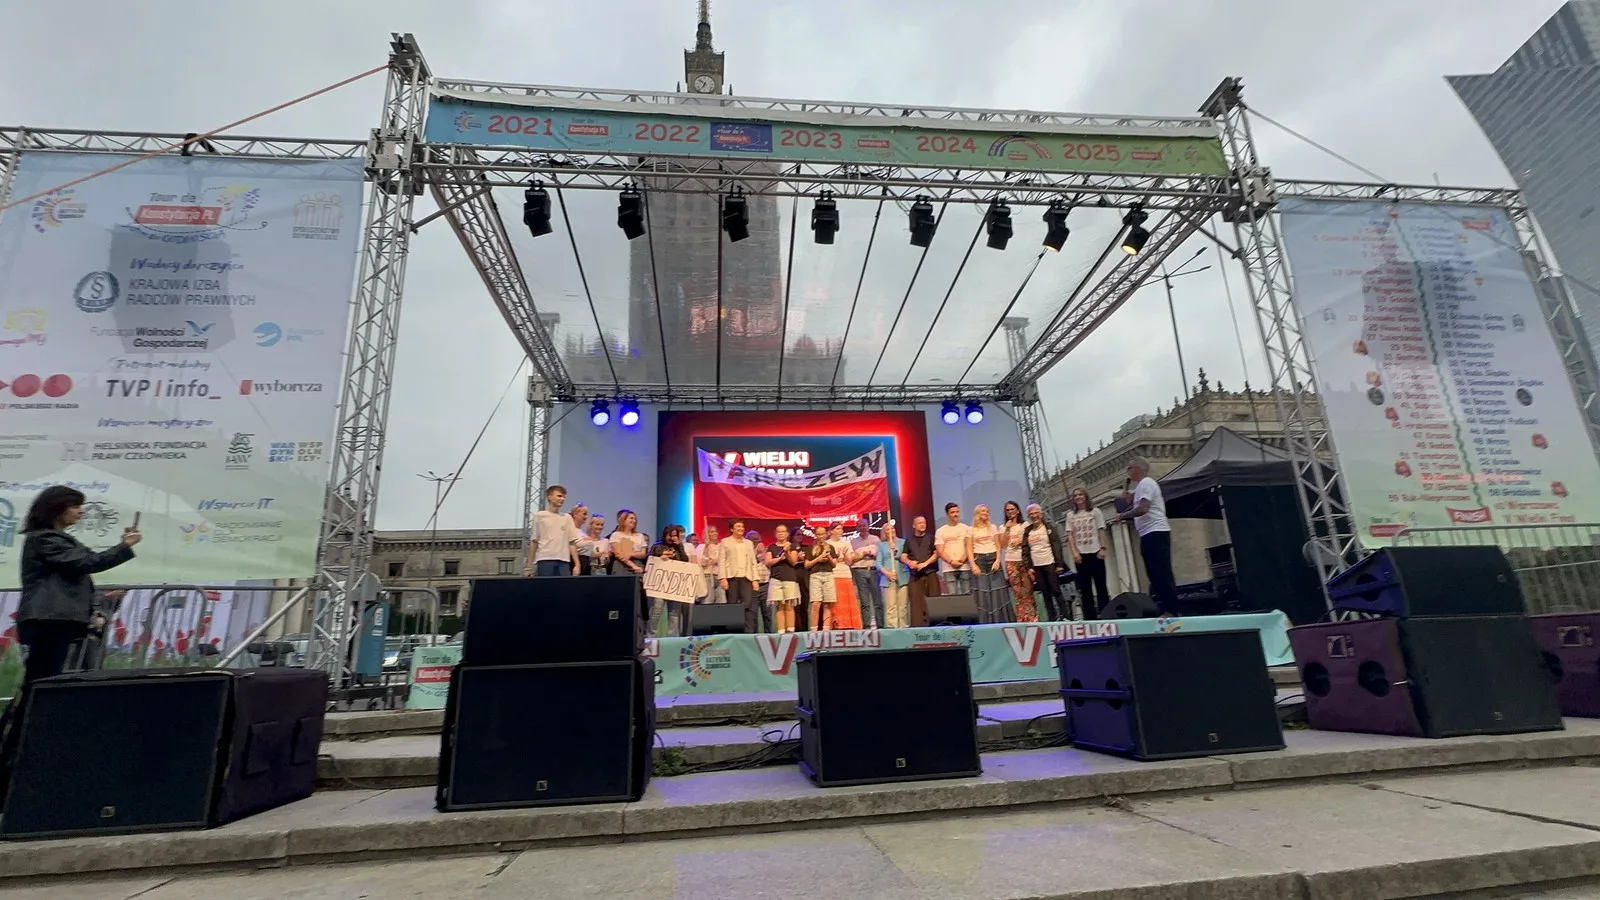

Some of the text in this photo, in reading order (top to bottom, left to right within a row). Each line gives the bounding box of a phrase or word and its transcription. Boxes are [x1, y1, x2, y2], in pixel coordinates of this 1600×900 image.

[487, 114, 554, 136] 2021
[634, 122, 701, 143] 2022
[781, 129, 843, 150] 2023
[917, 135, 978, 154] 2024
[1063, 143, 1122, 162] 2025
[128, 279, 220, 290] KRAJOWA IZBA
[126, 293, 256, 306] RADCÓW PRAWNYCH
[135, 326, 186, 337] Wolności
[133, 338, 209, 350] Gospodarczej
[106, 379, 151, 397] TVP
[254, 380, 323, 395] wyborcza
[153, 441, 207, 450] FUNDACJA
[743, 451, 810, 468] WIELKI
[197, 498, 275, 511] Wsparcie IT
[646, 563, 699, 598] LONDYN
[754, 629, 882, 676] V WIELKI
[1001, 623, 1119, 667] V WIELKI
